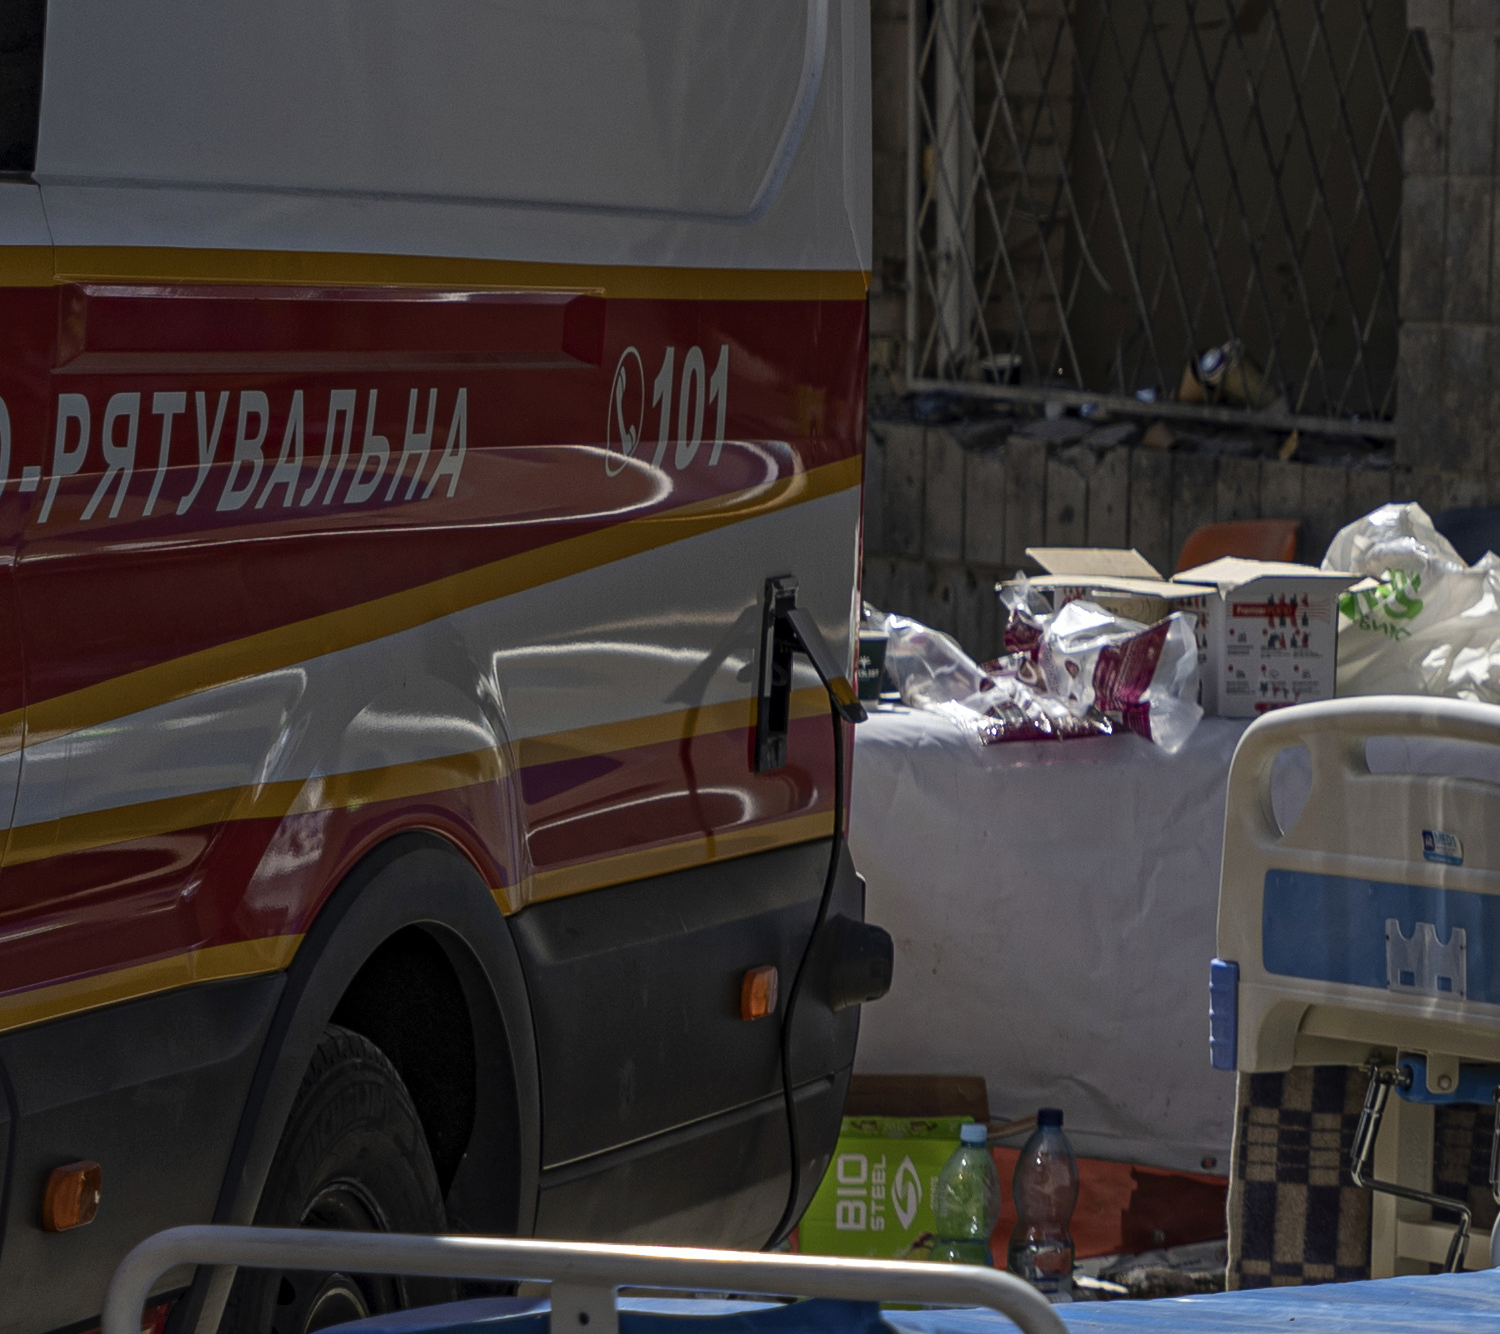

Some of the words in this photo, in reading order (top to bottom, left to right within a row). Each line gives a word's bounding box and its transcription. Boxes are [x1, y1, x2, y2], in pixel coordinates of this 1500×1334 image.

[0, 388, 469, 525] -РЯТУВАЛЬНА
[650, 343, 730, 470] 101
[835, 1153, 868, 1232] BIO
[870, 1154, 887, 1232] STEEL
